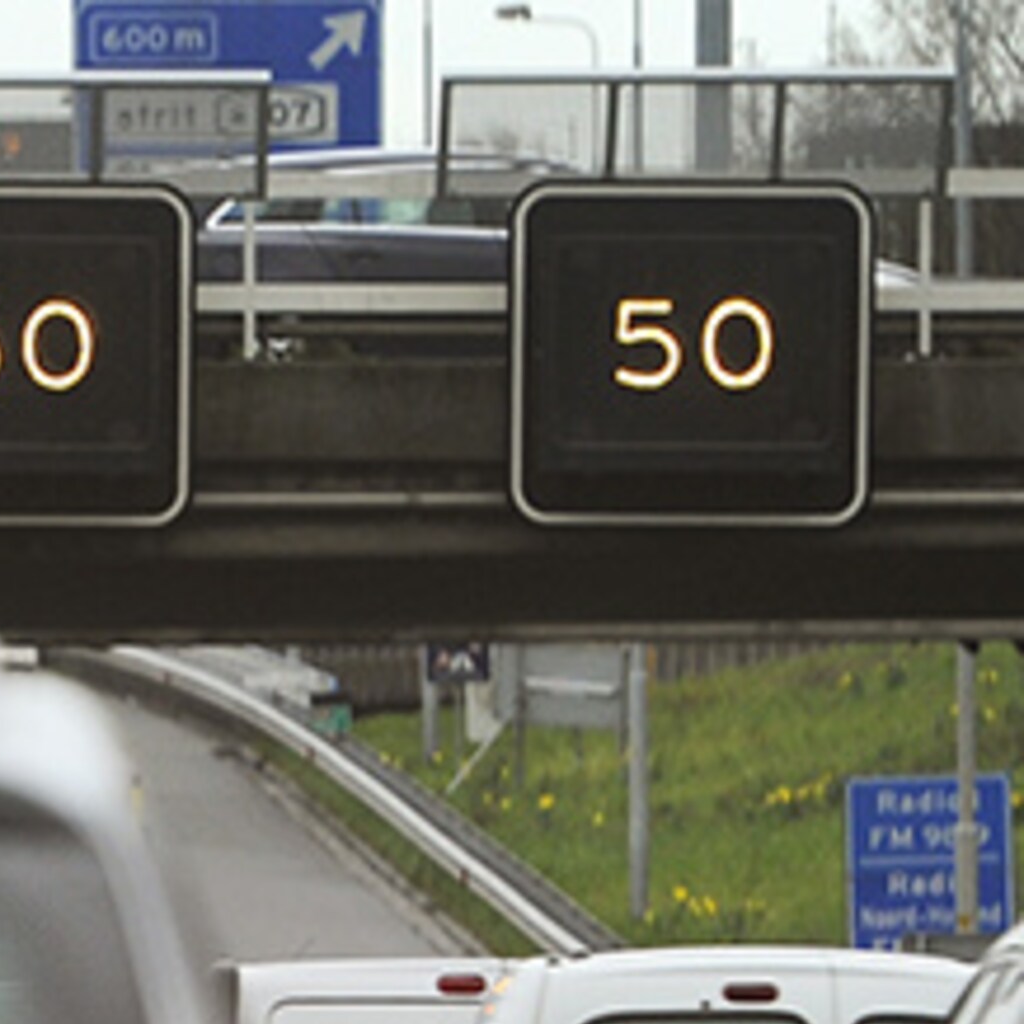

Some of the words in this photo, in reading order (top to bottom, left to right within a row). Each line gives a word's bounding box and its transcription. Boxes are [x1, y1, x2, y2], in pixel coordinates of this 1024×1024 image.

[102, 23, 168, 50] 600
[175, 28, 206, 50] m
[259, 101, 311, 126] 07
[613, 296, 776, 393] 50
[869, 825, 914, 849] FM
[887, 870, 961, 896] Radi
